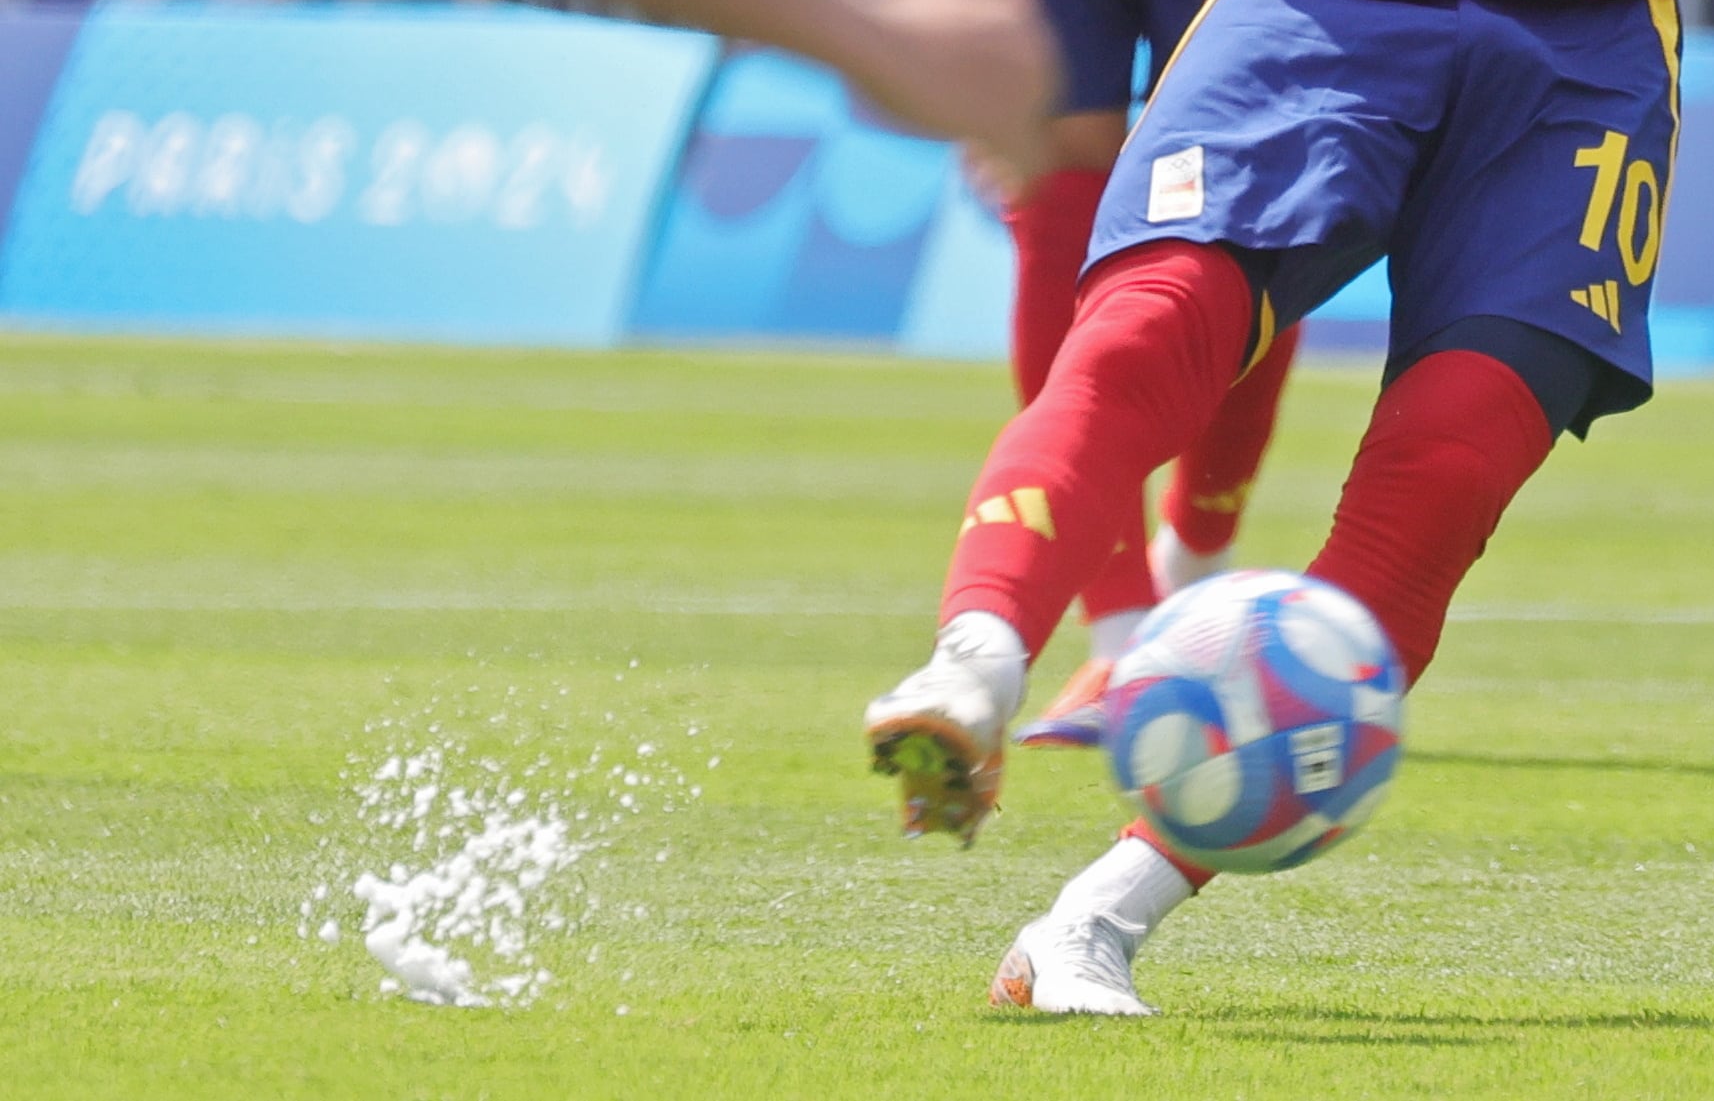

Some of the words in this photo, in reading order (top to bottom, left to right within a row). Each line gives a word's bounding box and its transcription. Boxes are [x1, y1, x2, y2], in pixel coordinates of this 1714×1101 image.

[69, 109, 356, 224] PARIS
[359, 118, 611, 231] 2024
[1574, 131, 1659, 286] 10
